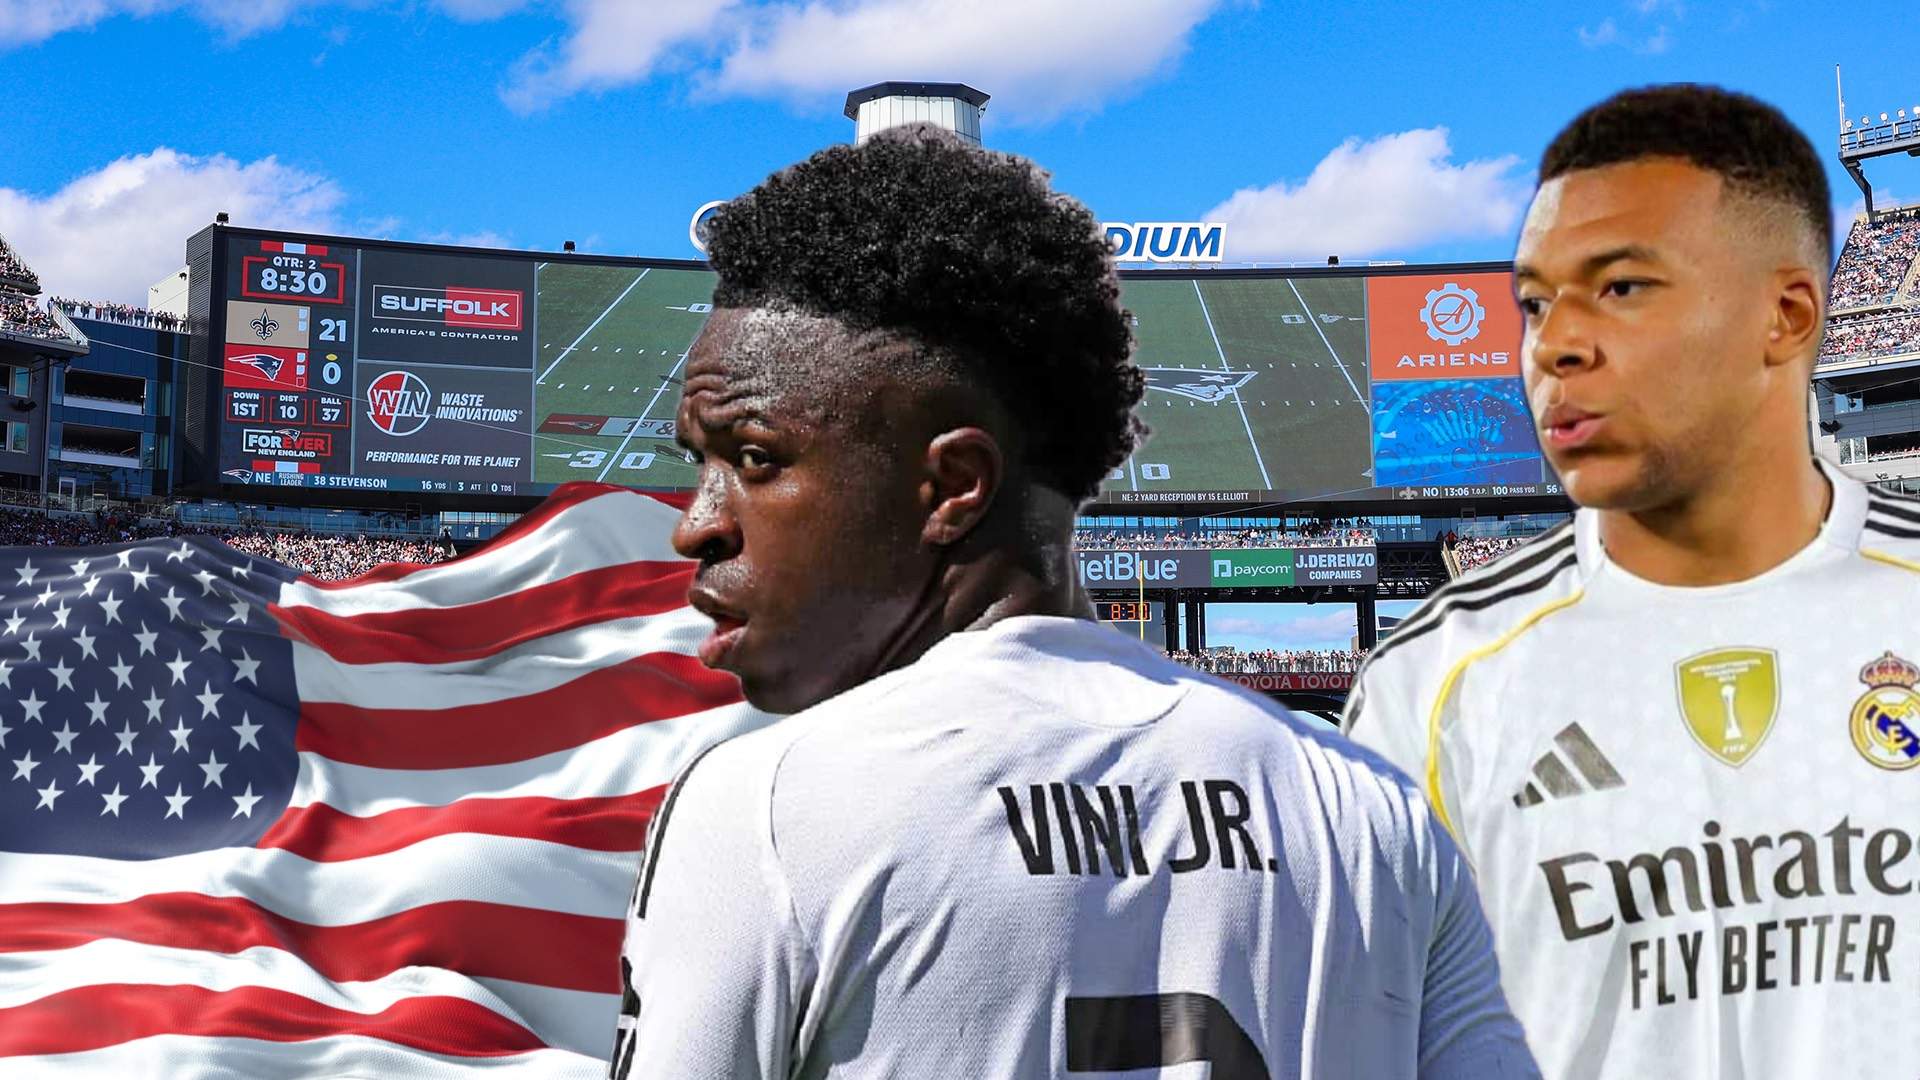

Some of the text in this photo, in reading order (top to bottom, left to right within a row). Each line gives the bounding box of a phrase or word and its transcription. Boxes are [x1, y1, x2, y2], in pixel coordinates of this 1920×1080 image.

[1102, 222, 1226, 261] DIUM
[273, 255, 317, 270] QTR: 2
[261, 267, 327, 295] 8:30
[381, 294, 510, 317] SUFFOLK
[319, 318, 347, 342] 21
[371, 326, 519, 342] AMERICA'S CONTRACTOR
[1396, 351, 1509, 368] ARIENS
[322, 361, 342, 385] 0
[233, 391, 260, 400] DOWN
[279, 394, 299, 403] DIST
[320, 397, 342, 405] BALL
[371, 388, 427, 417] WIN
[441, 392, 485, 407] WASTE
[232, 402, 259, 417] 1ST
[280, 405, 298, 419] 10
[321, 408, 341, 422] 37
[248, 434, 326, 451] FOREVER
[257, 448, 316, 458] NEW ENGLAND
[365, 451, 521, 468] PERFORMANCE FOR THE PLANET
[255, 472, 305, 483] NE RUSHING
[280, 479, 303, 487] LEADER
[314, 475, 388, 489] 38 STEVENSON
[421, 480, 446, 490] 16 YDS
[457, 482, 482, 491] 3 ATT
[491, 483, 512, 493] 0 TDS
[1422, 487, 1439, 497] NO
[1444, 487, 1469, 496] 13:06
[1492, 486, 1508, 495] 100
[1546, 484, 1558, 494] 56
[1134, 493, 1139, 502] 2
[1140, 493, 1159, 502] YARD
[1160, 492, 1196, 502] RECEPTION
[1197, 492, 1207, 501] BY
[1208, 492, 1216, 501] 15
[1295, 552, 1375, 569] J.DERENZO
[1079, 551, 1178, 586] jetBlue
[1234, 564, 1289, 577] paycom
[1309, 569, 1362, 580] COMPANIES
[1111, 603, 1148, 620] 8:30
[1228, 674, 1353, 689] TOYOTA TOYOT
[997, 779, 1279, 879] VINI JR.
[1537, 815, 1920, 942] Emirate
[1630, 914, 1896, 1011] FLY BETTER
